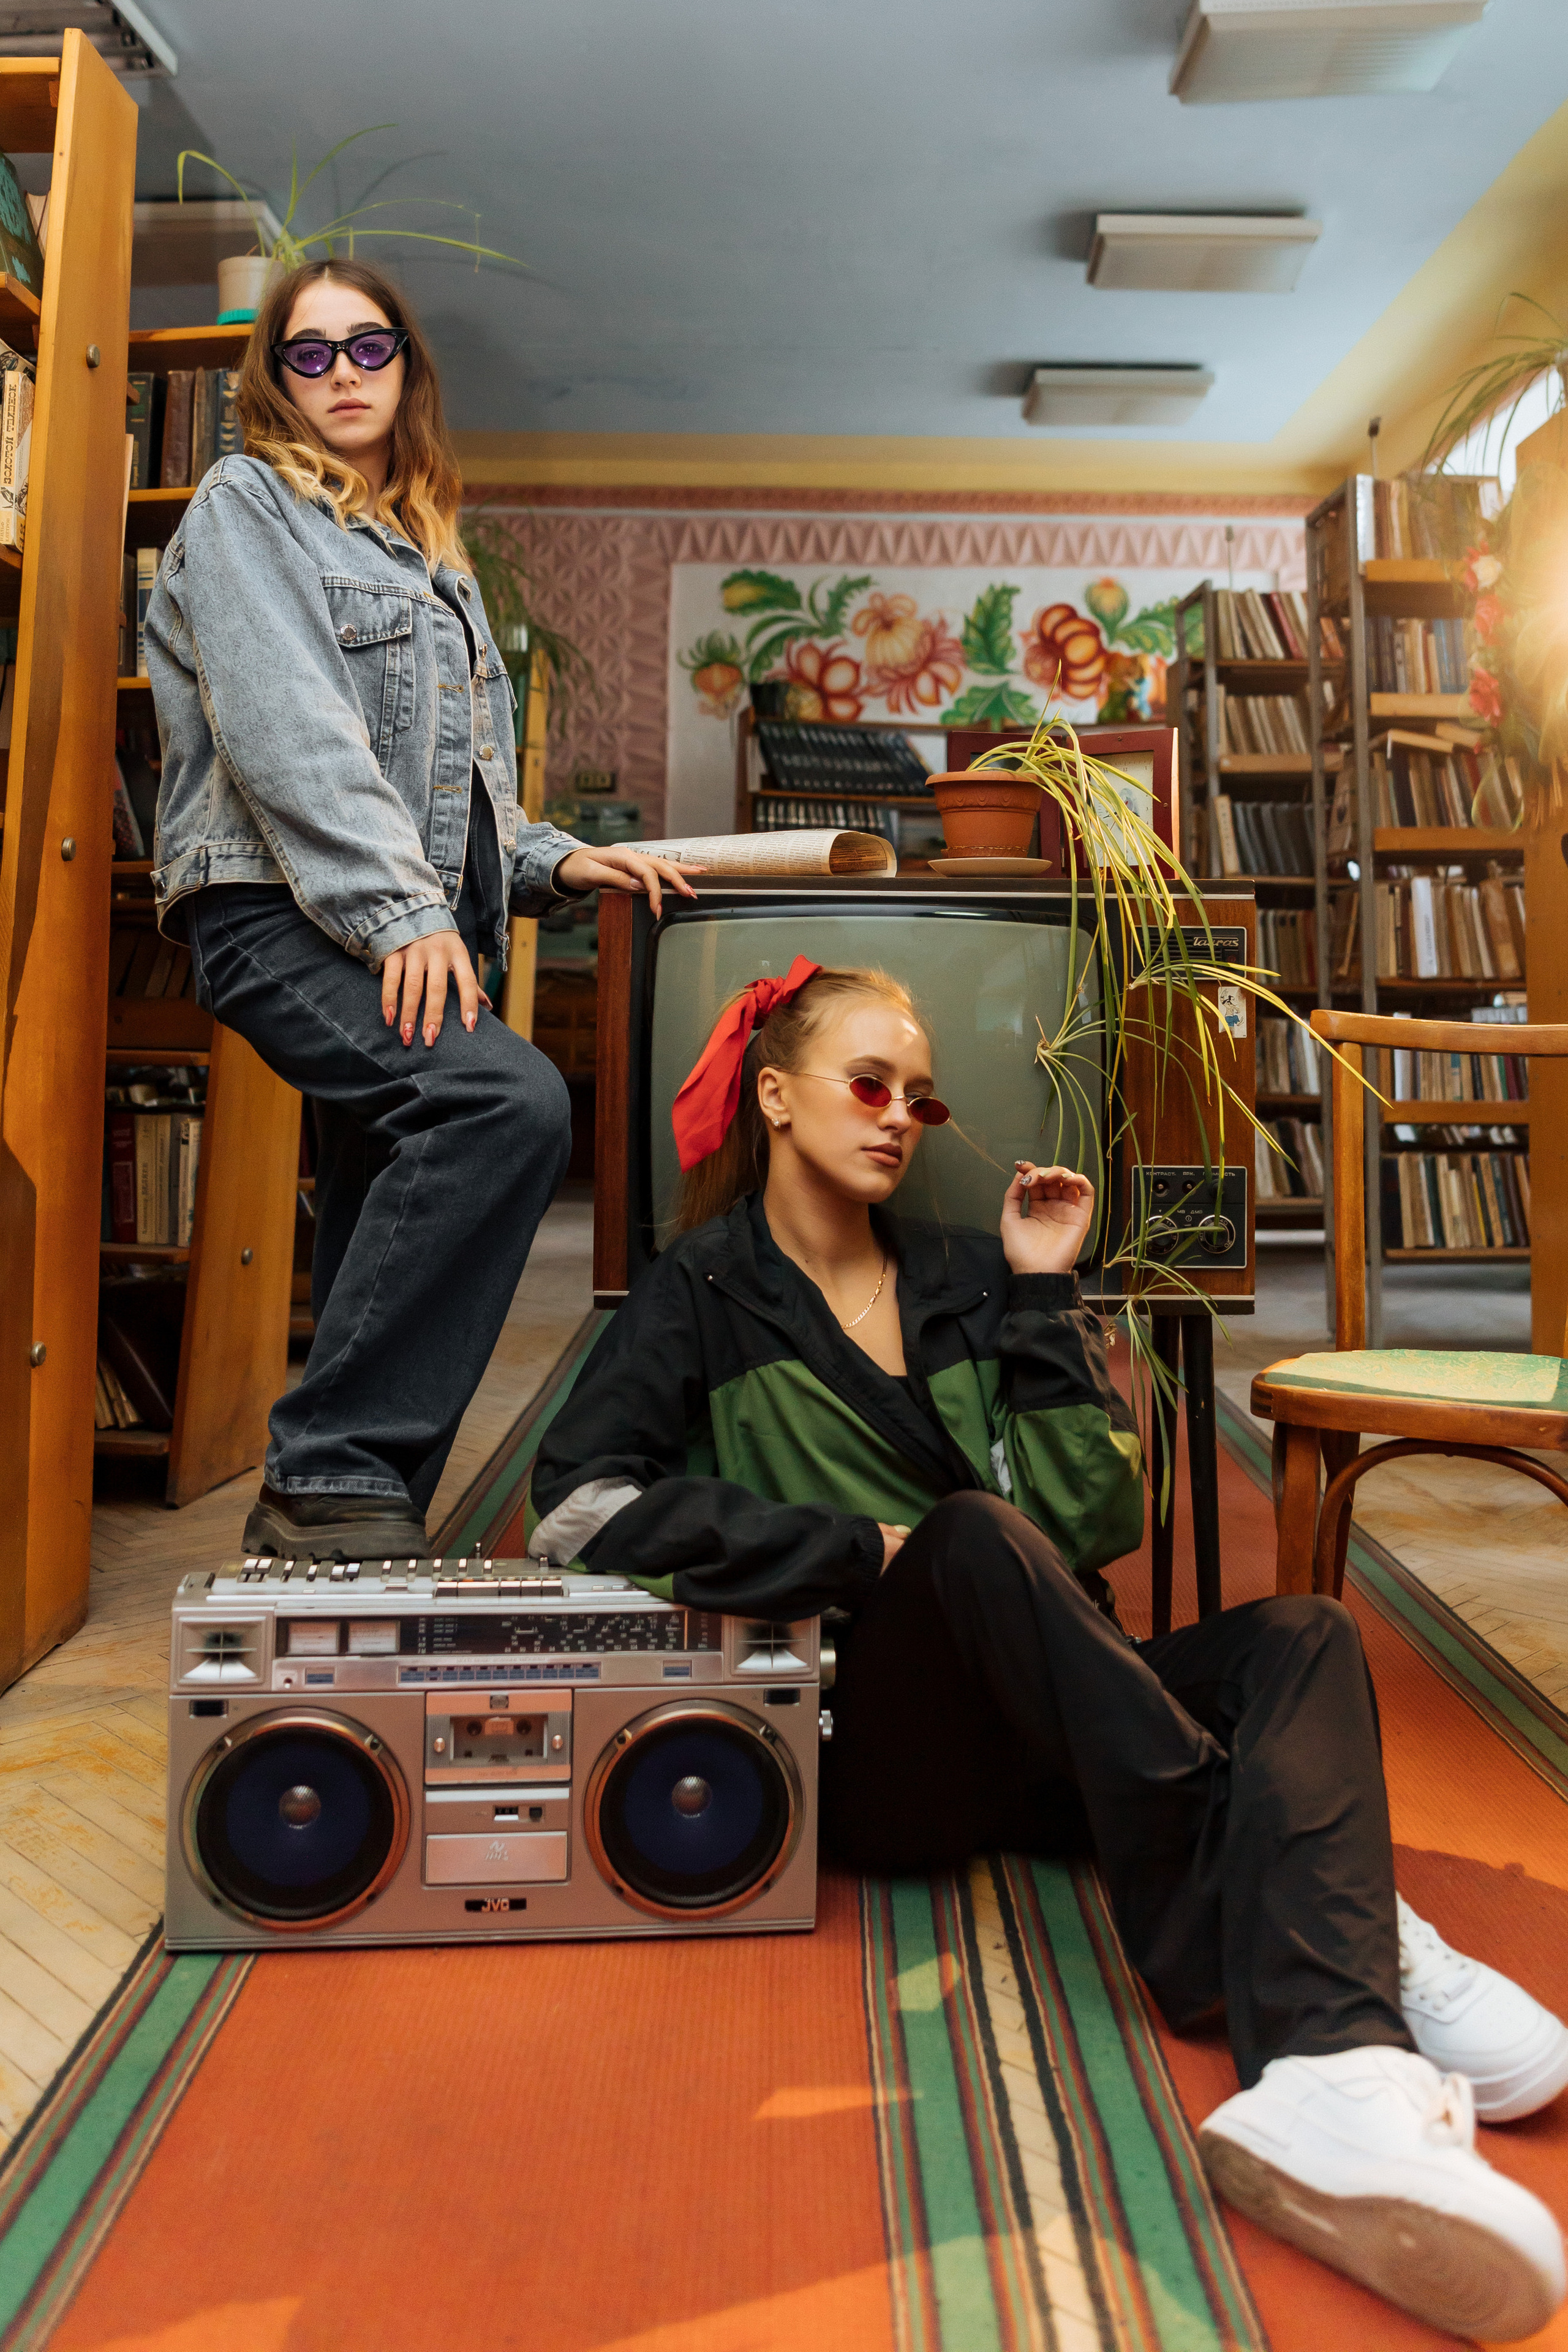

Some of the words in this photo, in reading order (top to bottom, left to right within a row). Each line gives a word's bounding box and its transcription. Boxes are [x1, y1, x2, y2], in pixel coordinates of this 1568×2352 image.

[7, 384, 17, 432] ТЕЛЕНОК
[4, 436, 13, 484] ЗОЛОТОЙ
[481, 1898, 509, 1912] JVC
